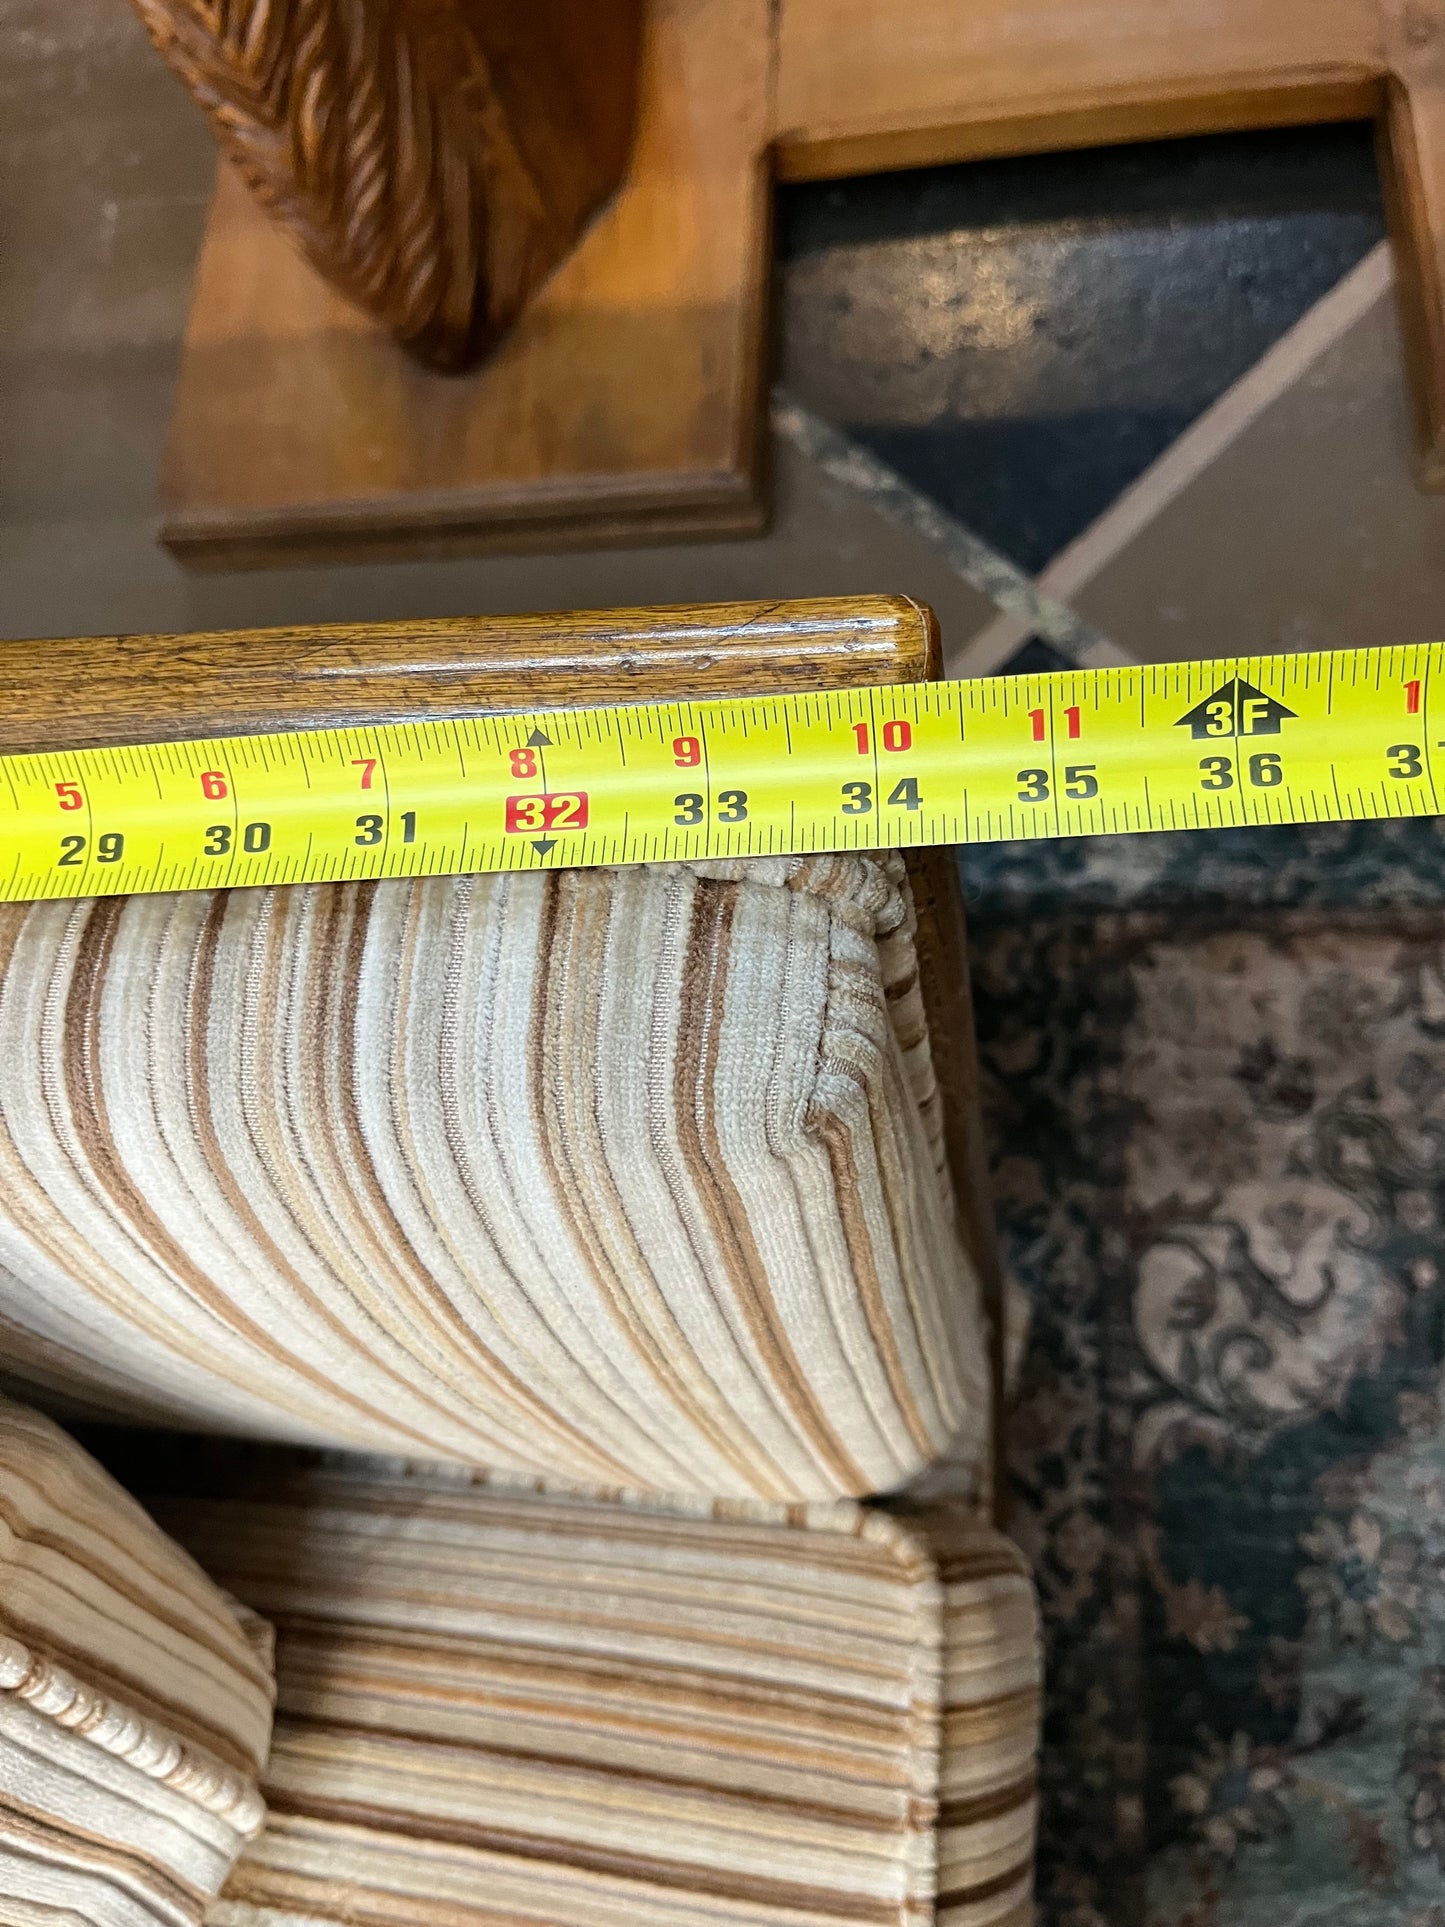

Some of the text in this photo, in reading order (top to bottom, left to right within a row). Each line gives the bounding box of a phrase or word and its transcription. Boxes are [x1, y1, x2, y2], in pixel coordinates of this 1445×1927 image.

[55, 782, 82, 810] 5
[201, 771, 227, 800] 6
[352, 759, 376, 790] 7
[511, 748, 537, 778] 8
[672, 737, 701, 768] 9
[852, 720, 911, 755] 10
[1028, 706, 1081, 741] 11
[1205, 697, 1268, 736] 3F
[58, 740, 1445, 867] 29 30 31 32 33 34 35 36 3
